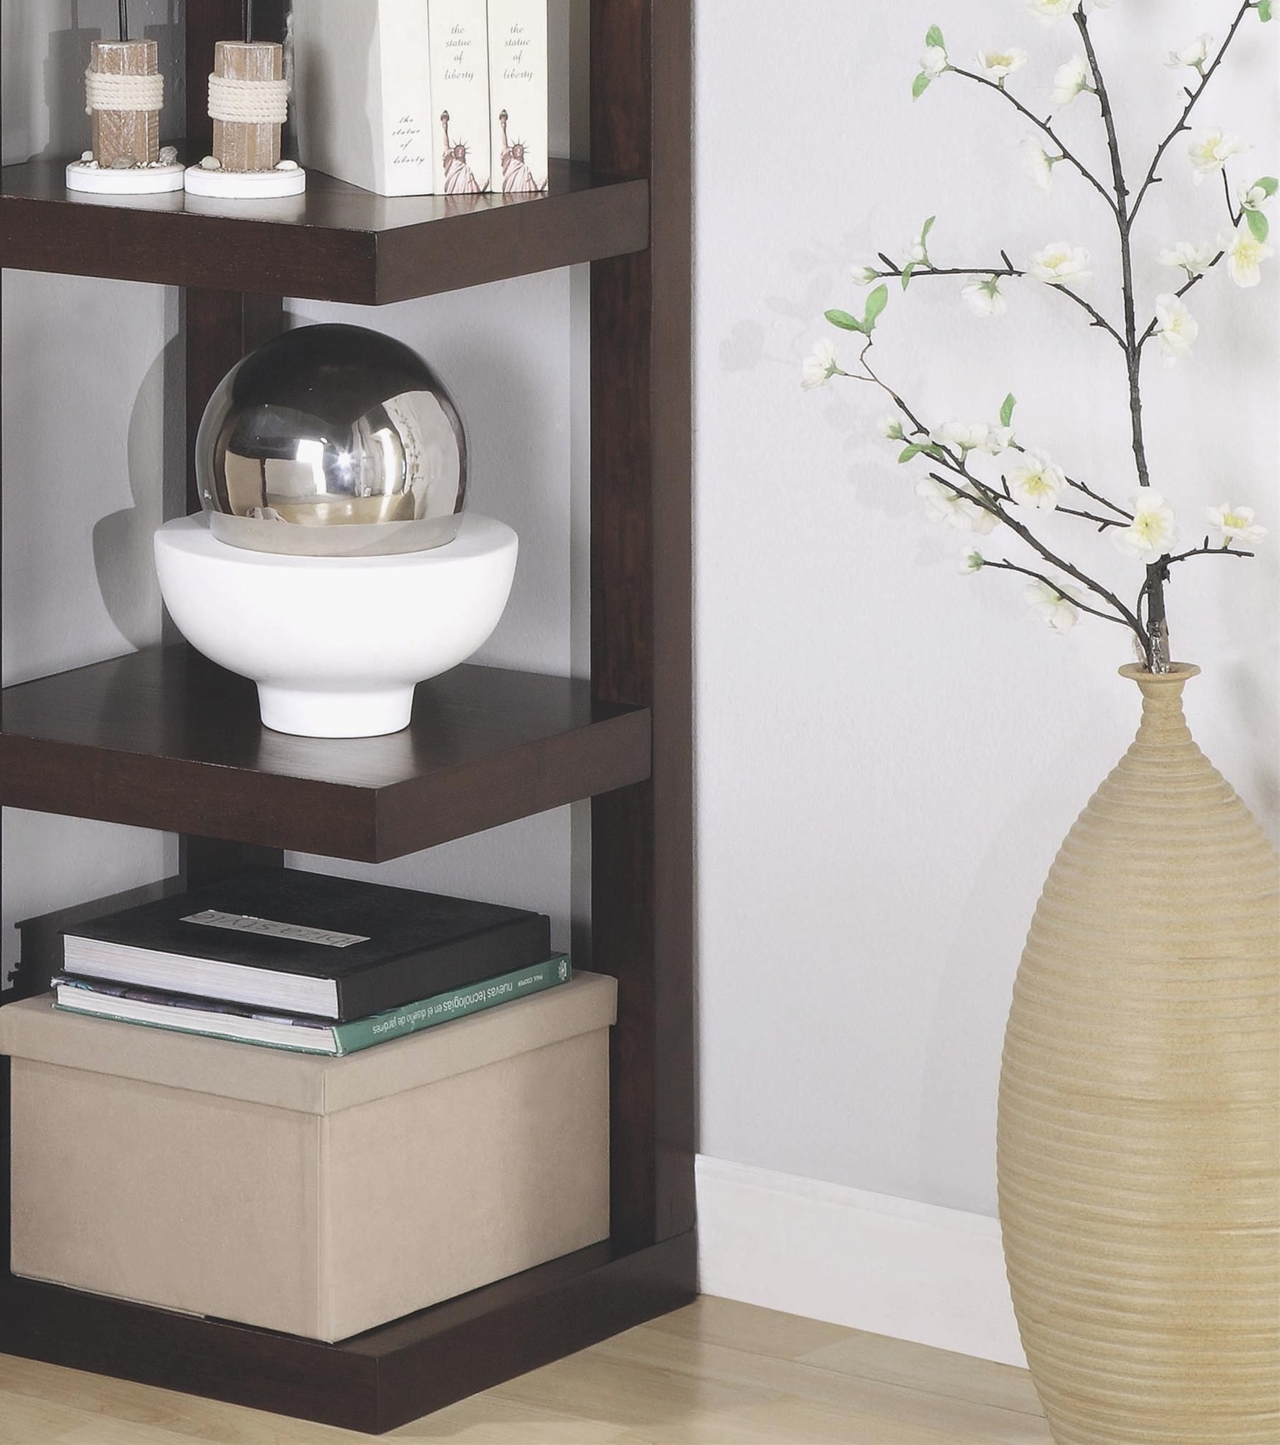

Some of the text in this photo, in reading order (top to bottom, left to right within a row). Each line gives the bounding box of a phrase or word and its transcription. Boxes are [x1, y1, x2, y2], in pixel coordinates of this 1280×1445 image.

[451, 23, 465, 35] the
[510, 23, 524, 34] the
[445, 38, 472, 48] statue
[504, 38, 531, 47] statue
[454, 50, 464, 64] of
[513, 50, 523, 64] of
[444, 68, 474, 81] liberty
[503, 68, 533, 81] liberty
[399, 115, 414, 124] the
[400, 138, 413, 150] of
[487, 981, 513, 999] nuevas
[442, 987, 487, 1013] tecnologías
[427, 1006, 435, 1018] el
[435, 1003, 443, 1014] en
[397, 1015, 406, 1027] de
